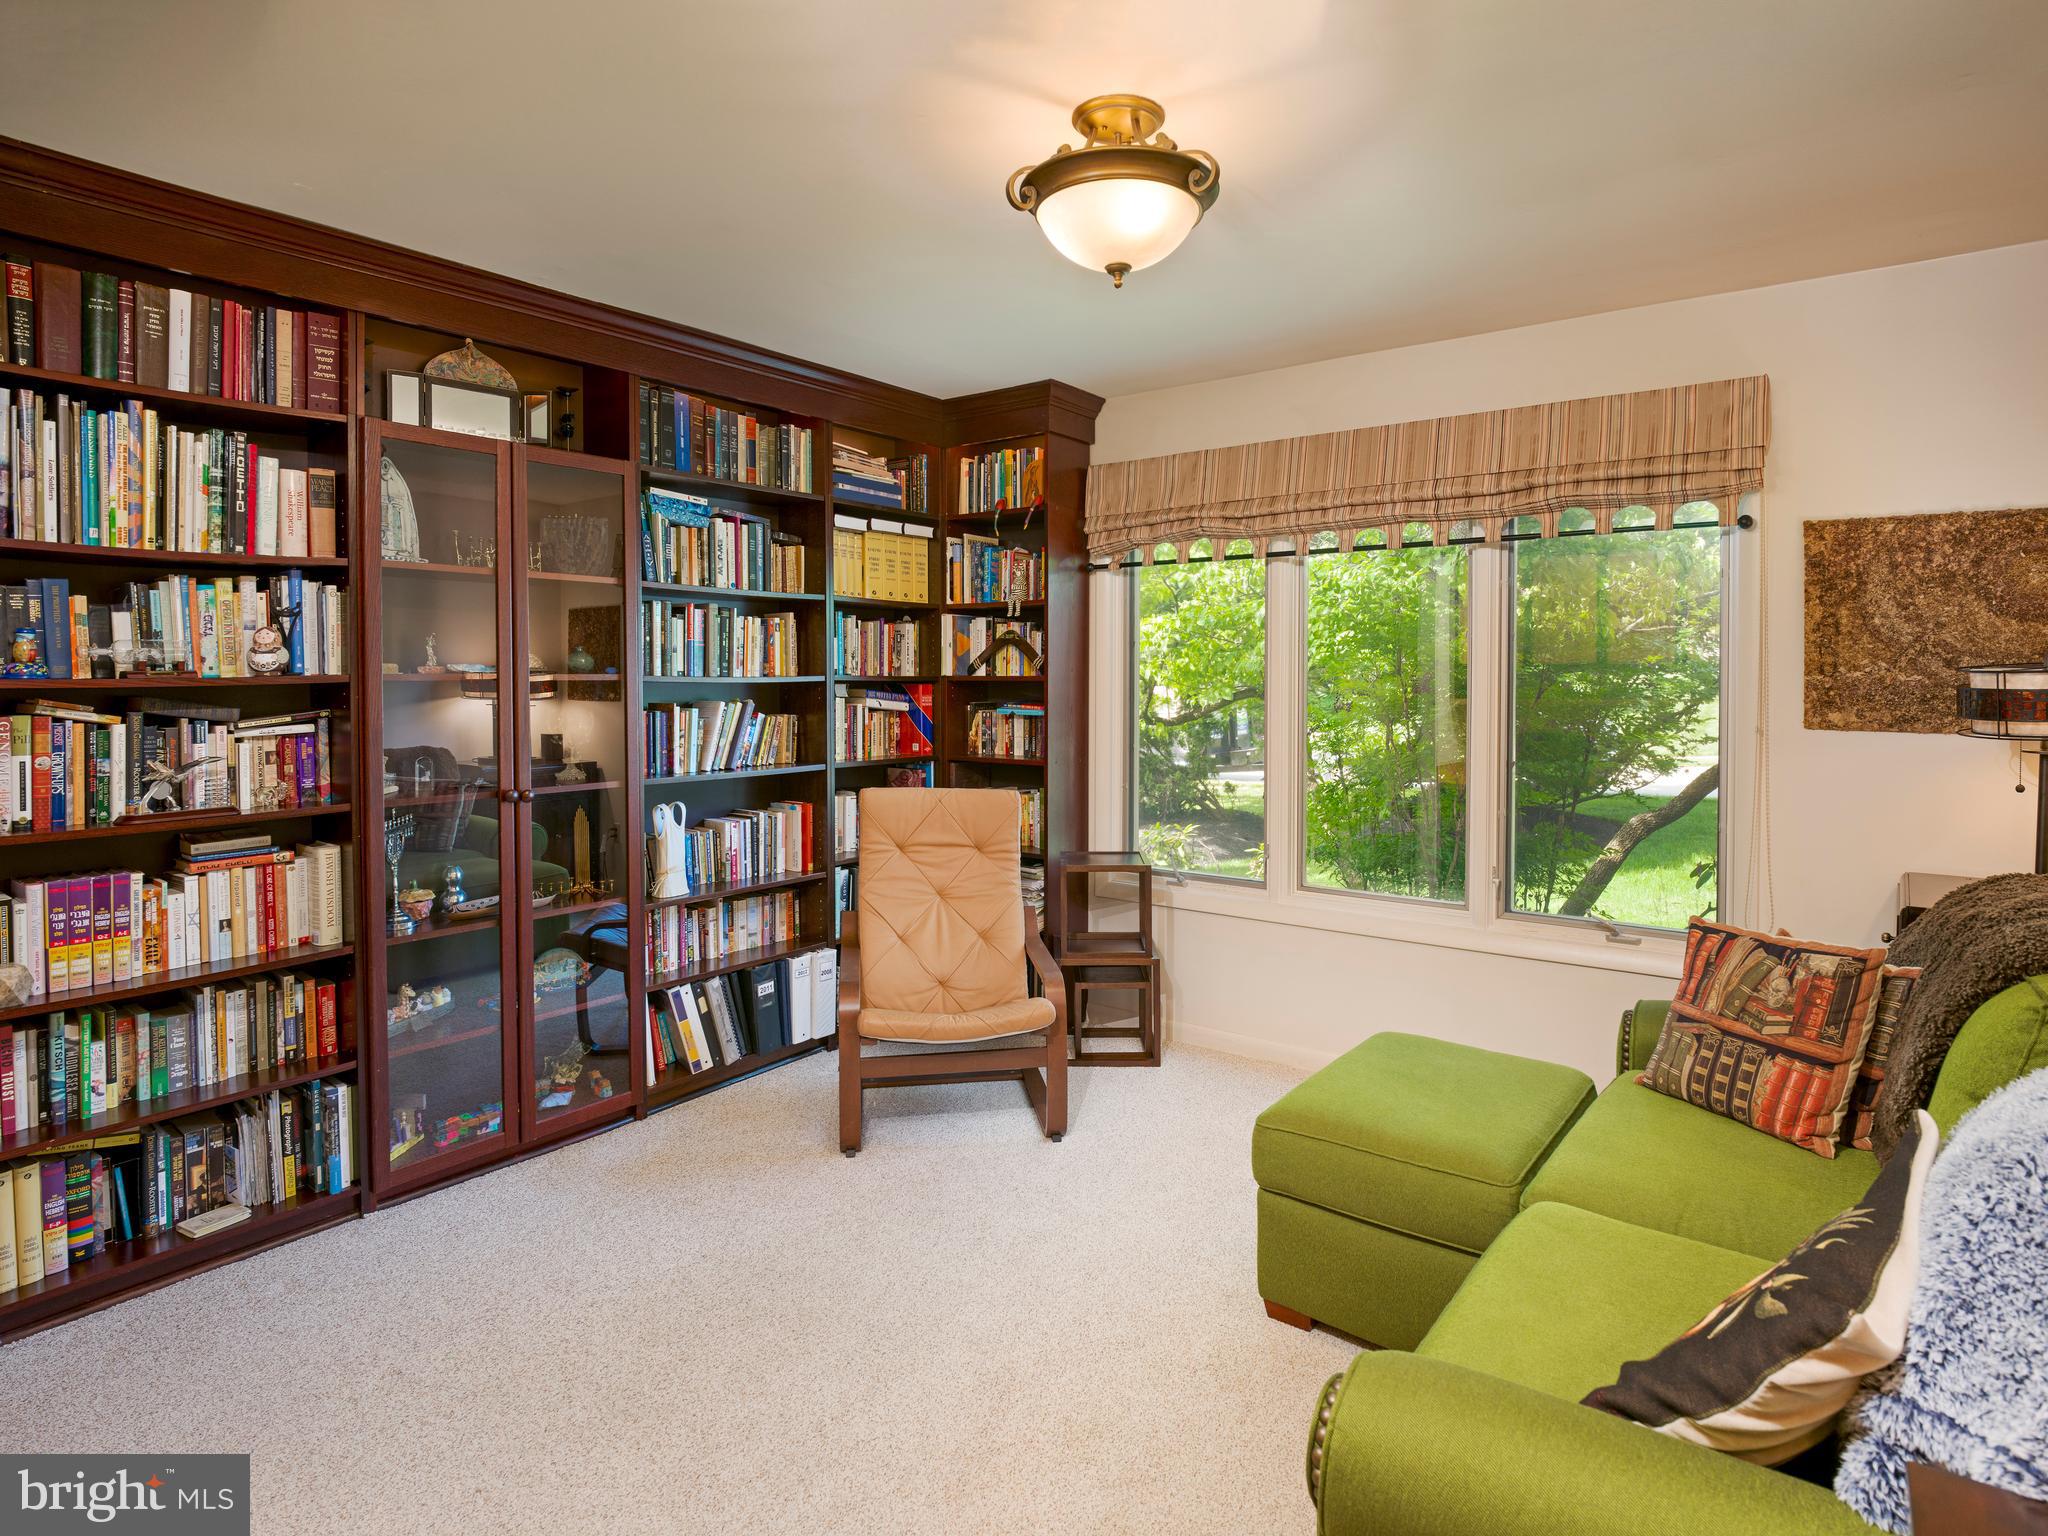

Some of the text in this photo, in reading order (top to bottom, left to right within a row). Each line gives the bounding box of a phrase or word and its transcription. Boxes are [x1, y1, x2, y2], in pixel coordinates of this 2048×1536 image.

[285, 489, 295, 537] Shakespeare
[222, 600, 236, 666] OPERATION BABYLON
[0, 721, 10, 785] GENOME
[13, 735, 31, 744] Pill
[133, 716, 141, 795] JOHN GRISHAM ROOSTER
[324, 853, 334, 928] JEWISH WISDOM
[146, 938, 159, 966] EXILE
[759, 984, 774, 994] 2011
[1, 1039, 14, 1102] BLIND TRUST
[15, 1040, 23, 1062] blink
[66, 1050, 79, 1093] MIDDLESEX
[147, 1136, 155, 1151] JOHN
[284, 1116, 292, 1155] Photography
[44, 1199, 65, 1209] ENGLISH
[45, 1205, 65, 1216] HEBREW
